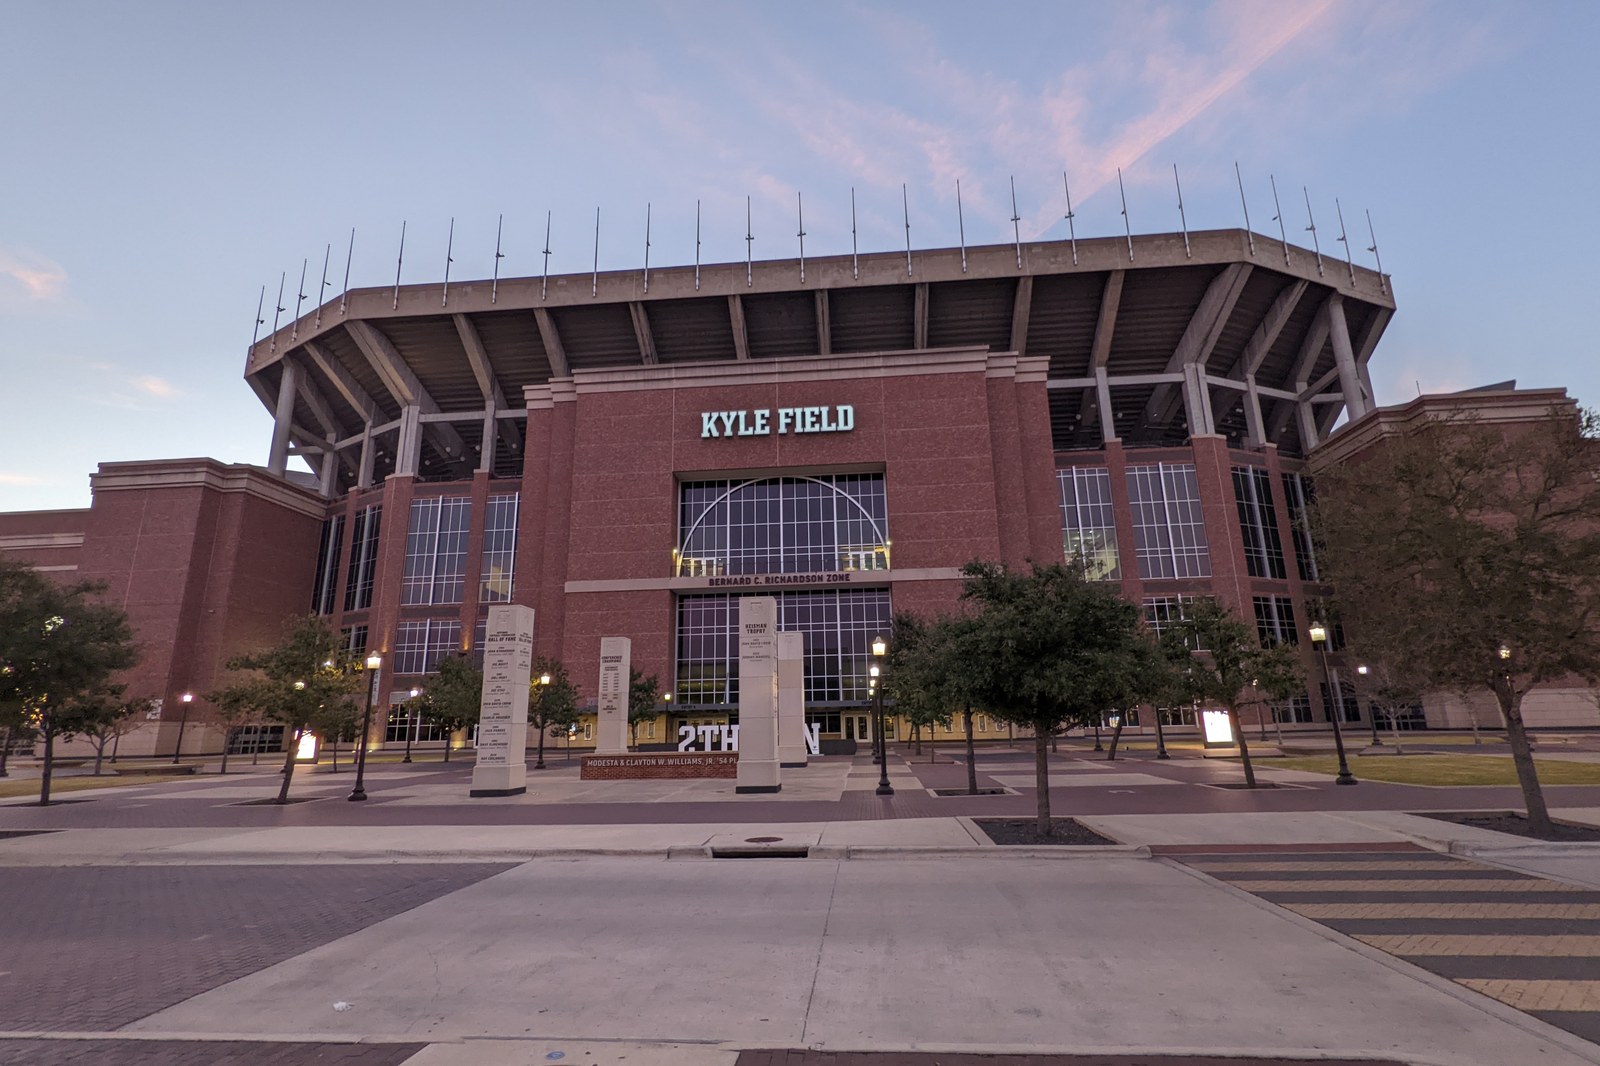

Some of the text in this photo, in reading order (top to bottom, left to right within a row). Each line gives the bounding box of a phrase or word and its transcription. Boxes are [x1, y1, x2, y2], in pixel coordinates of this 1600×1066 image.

[701, 405, 855, 438] KYLE FIELD
[709, 573, 851, 586] BERNARD C. RICHARDSON ZONE
[587, 759, 619, 767] MODESTA
